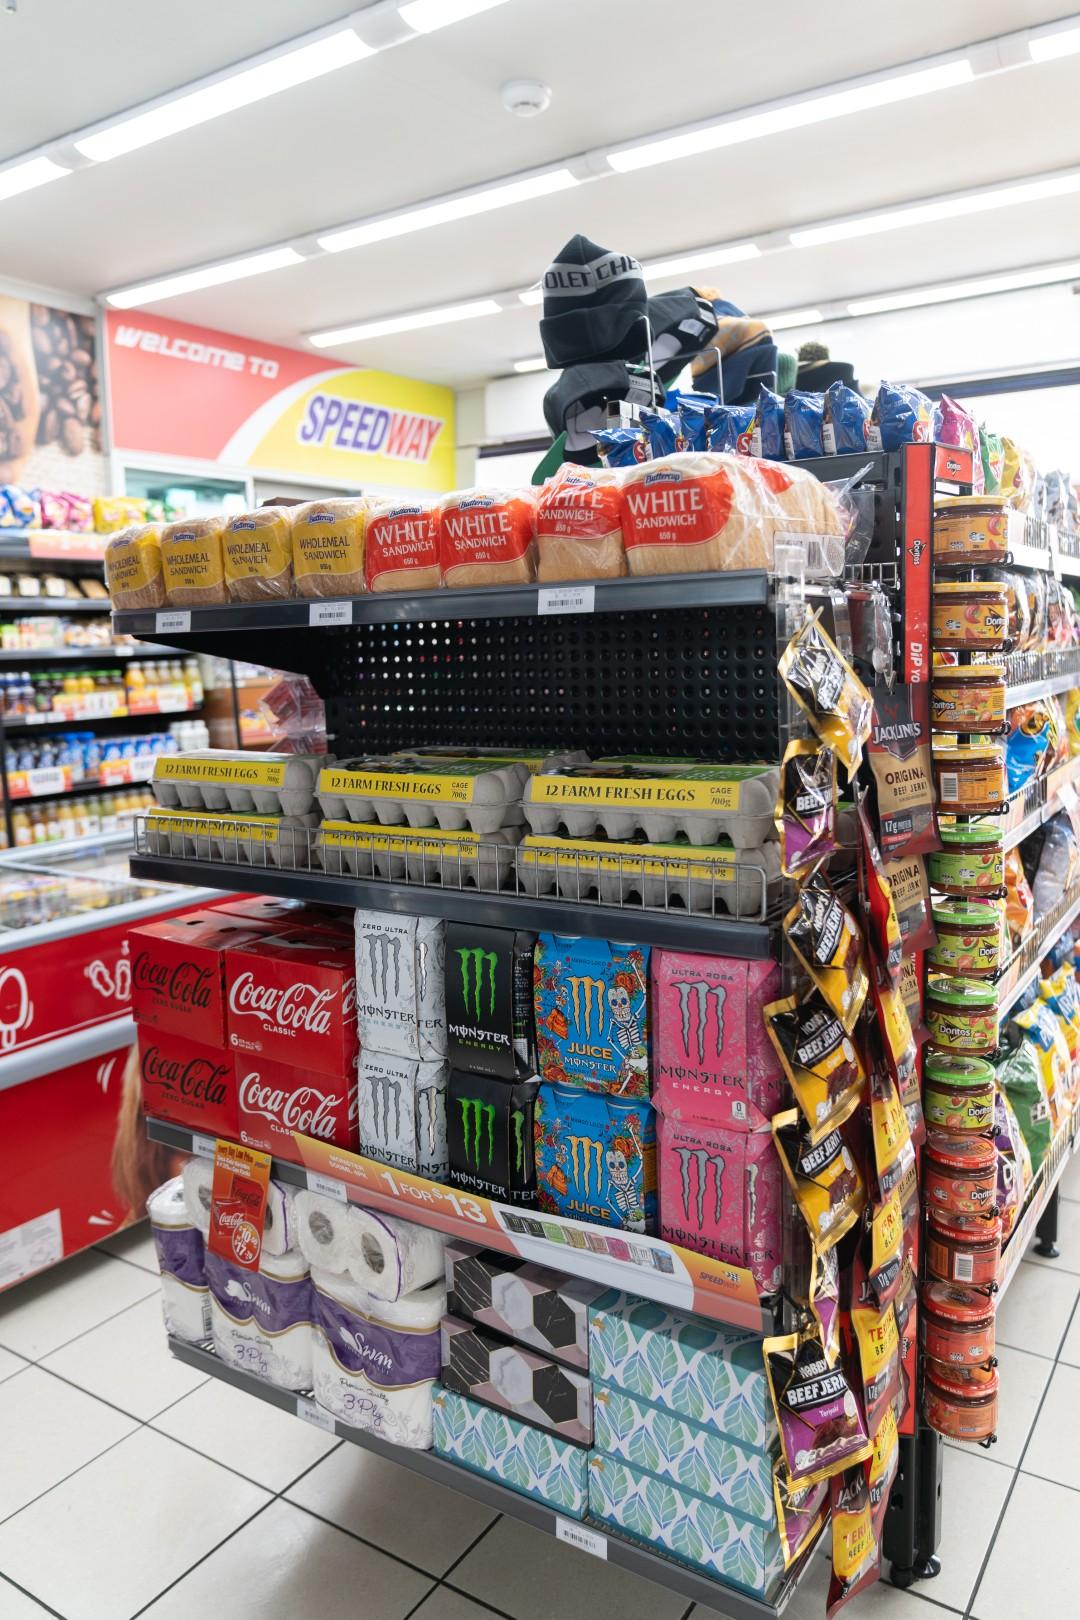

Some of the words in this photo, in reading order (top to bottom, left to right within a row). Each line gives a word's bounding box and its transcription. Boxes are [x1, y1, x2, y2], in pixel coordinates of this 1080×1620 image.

[301, 395, 443, 461] SPEEDWAY
[647, 472, 681, 485] Buttercup
[627, 488, 704, 515] WHITE
[445, 511, 512, 538] WHITE
[539, 509, 594, 522] SANDWICH
[636, 514, 697, 530] SANDWICH
[374, 517, 436, 546] WHITE
[227, 542, 271, 556] WHOLEMEAL
[300, 535, 350, 550] WHOLEMEAL
[383, 540, 433, 558] SANDWICH
[455, 535, 507, 551] SANDWICH
[167, 553, 210, 569] WHOLEMEAL
[304, 549, 347, 562] SANDWICH
[913, 539, 921, 567] Doritos
[170, 565, 207, 577] SANDWICH
[165, 764, 174, 775] 12
[175, 764, 200, 776] FARM
[202, 765, 231, 778] FRESH
[234, 768, 258, 780] EGGS
[330, 777, 341, 787] 12
[343, 777, 372, 790] FARM
[375, 779, 410, 792] FRESH
[413, 782, 441, 795] EGGS
[452, 782, 468, 790] CAGE
[452, 790, 468, 801] 700g
[546, 785, 558, 796] 12
[561, 785, 601, 799] FARM
[605, 787, 652, 801] FRESH
[656, 789, 696, 803] EGGS
[710, 786, 733, 795] CAGE
[710, 796, 731, 808] 700g
[362, 923, 382, 932] ZERO
[385, 926, 409, 936] ULTRA
[133, 951, 215, 1009] Coca-Cola
[672, 968, 702, 979] ULTRA
[706, 972, 734, 982] ROSA
[229, 971, 339, 1037] Coca-Cola
[357, 1003, 418, 1025] MONSTER
[230, 1033, 239, 1046] 6
[263, 1023, 297, 1038] CLASSIC
[448, 1023, 511, 1046] MONSTER
[939, 1024, 971, 1037] Doritos
[458, 1038, 501, 1053] ENERGY
[567, 1041, 613, 1061] JUICE
[797, 1036, 824, 1064] BEEF
[364, 1064, 384, 1074] ZERO
[386, 1069, 409, 1080] ULTRA
[563, 1055, 617, 1075] MONSTER
[141, 1046, 233, 1105] Coca-Cola
[659, 1064, 745, 1091] MONSTER
[672, 1081, 733, 1097] ENERGY
[239, 1072, 345, 1139] Coca-Cola
[240, 1130, 249, 1143] 6
[270, 1124, 294, 1136] CLASS
[673, 1133, 702, 1146] ULTRA
[706, 1141, 734, 1154] ROSA
[360, 1142, 416, 1169] MONSTER
[800, 1150, 826, 1174] BEEF
[380, 1171, 401, 1197] 1
[400, 1182, 434, 1204] FOR
[450, 1169, 507, 1199] MONSTER
[567, 1199, 611, 1221] JUICE
[661, 1224, 742, 1261] MONSTER
[243, 1281, 272, 1315] Swan
[234, 1344, 245, 1360] 3
[246, 1347, 268, 1373] Ply
[355, 1332, 393, 1370] Swan
[786, 1383, 820, 1406] BEEF
[343, 1393, 356, 1410] 3
[357, 1397, 385, 1427] Ply
